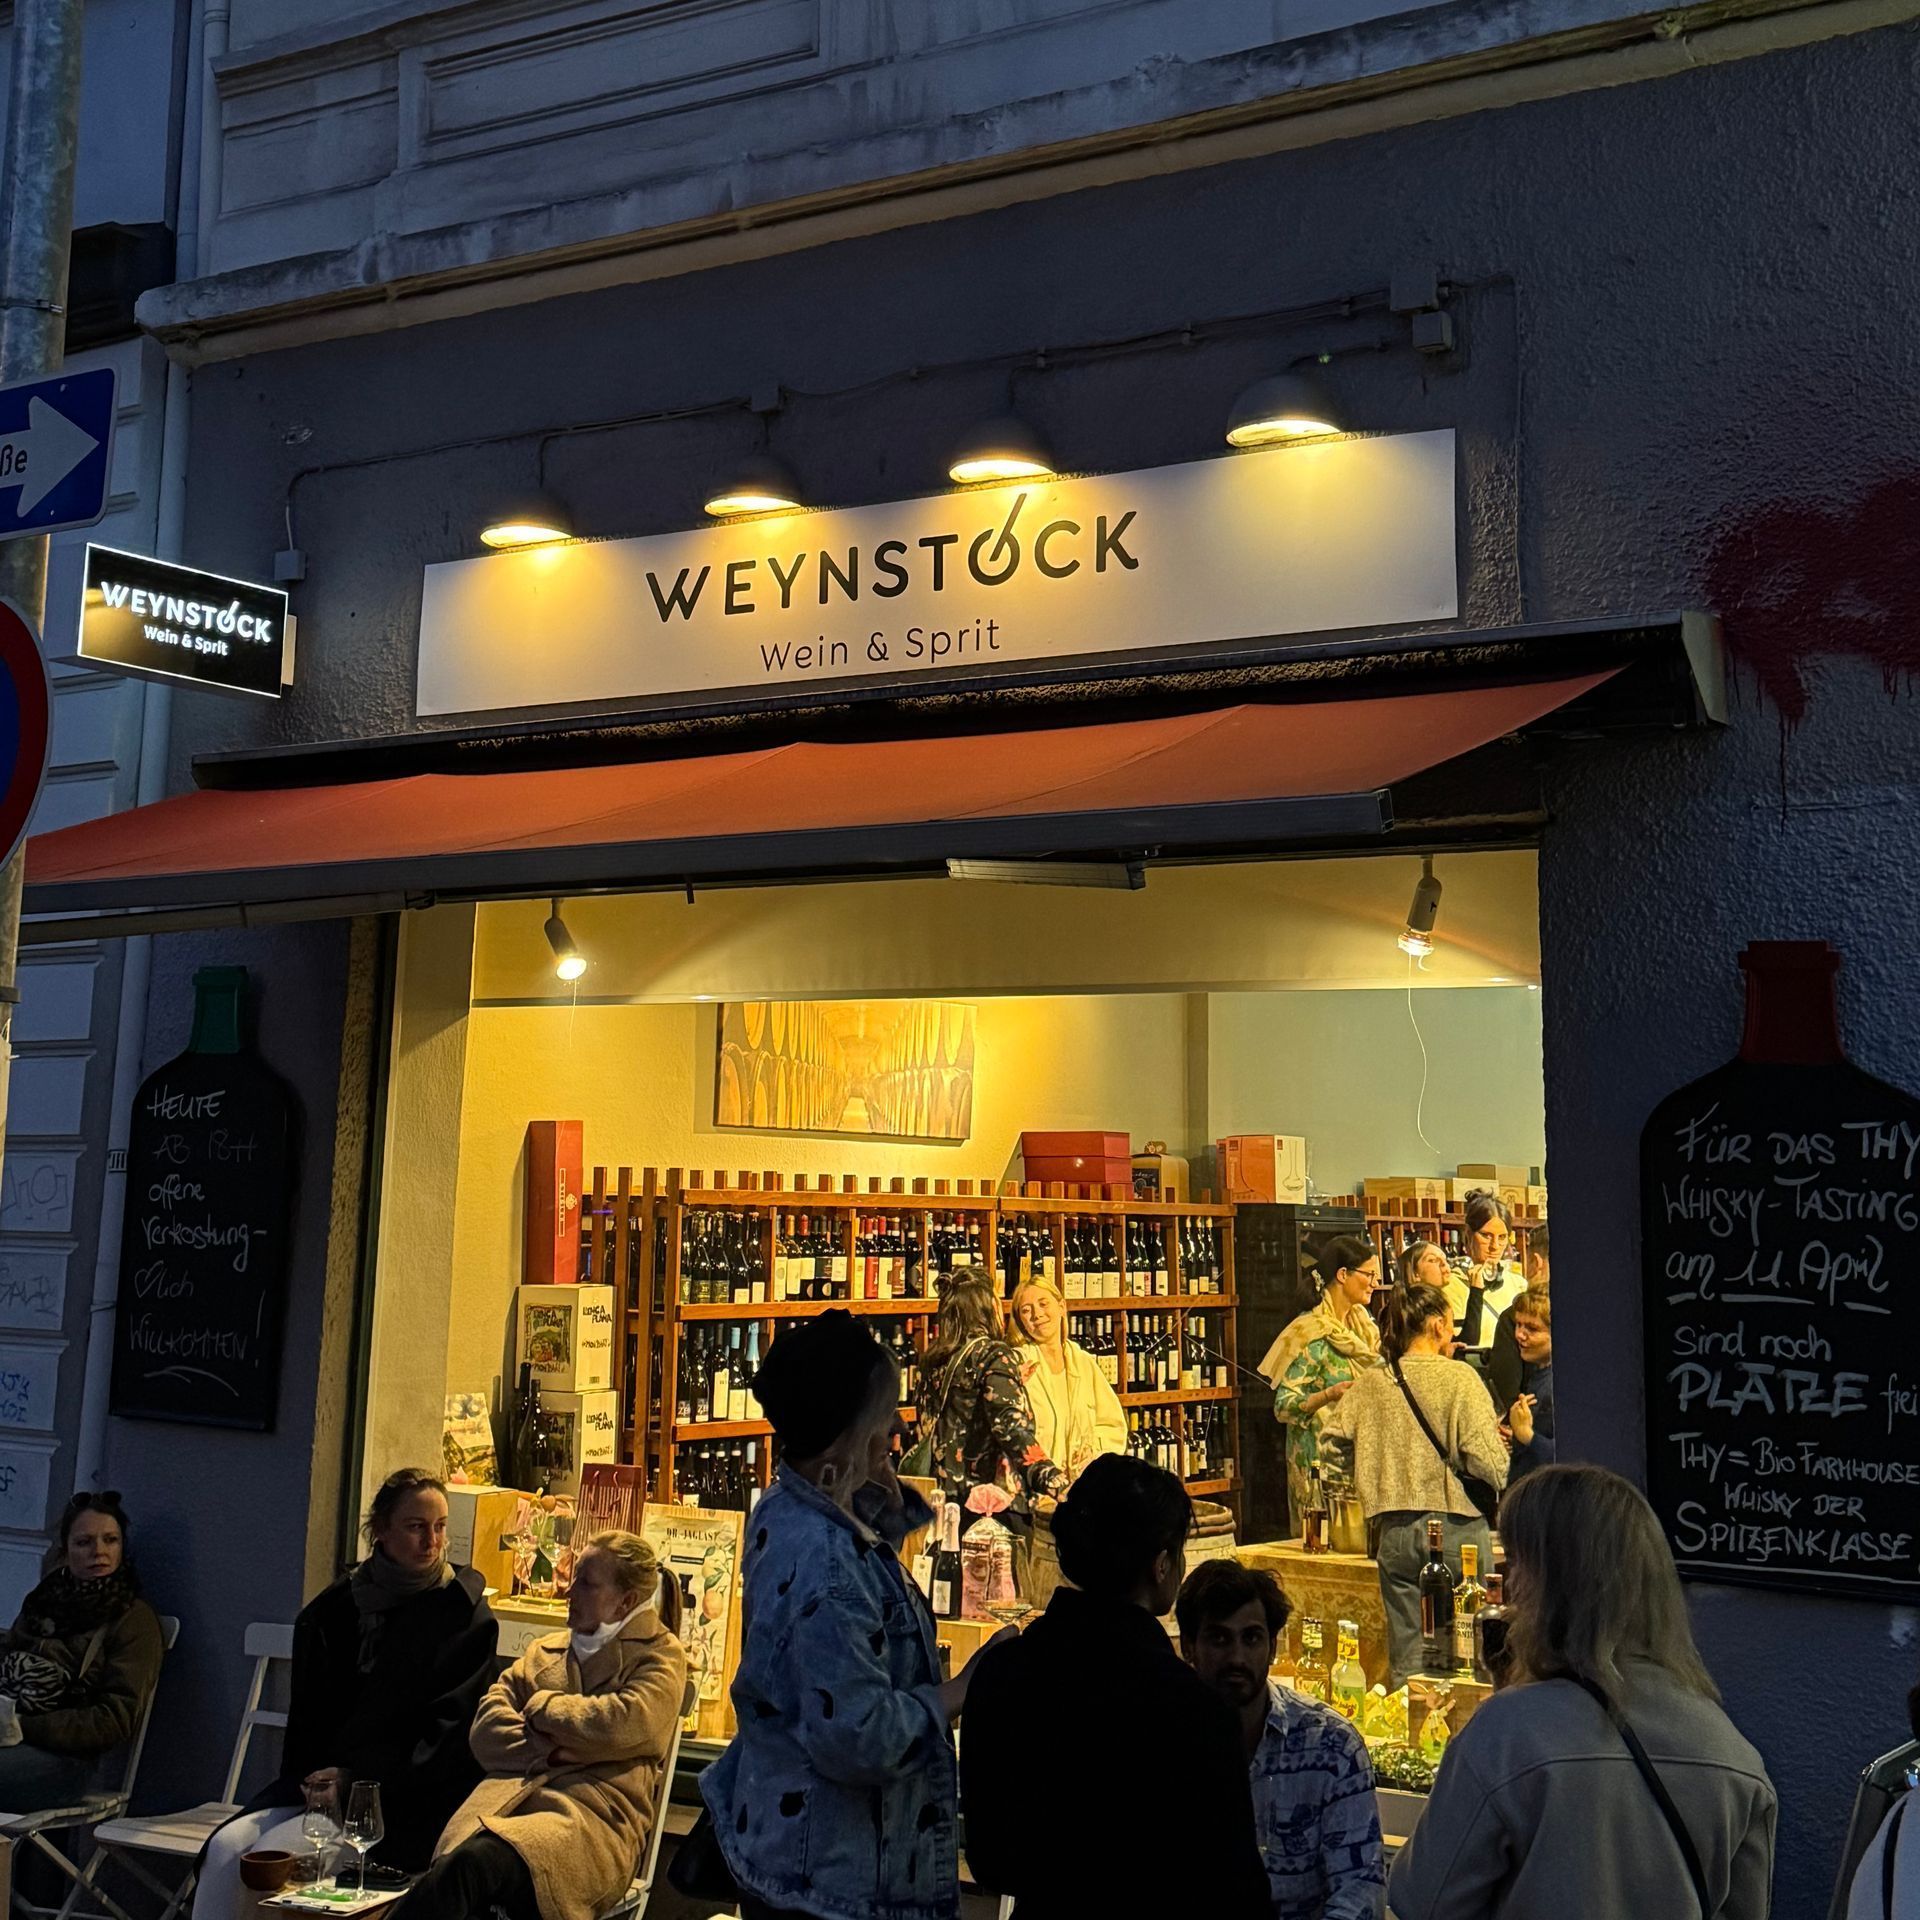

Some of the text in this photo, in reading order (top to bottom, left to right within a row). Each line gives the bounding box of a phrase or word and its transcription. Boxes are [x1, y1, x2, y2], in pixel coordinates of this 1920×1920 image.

[646, 493, 1139, 623] WEYNSTOCK
[101, 581, 272, 643] WEYNSTOCK
[143, 624, 229, 657] Wein & Sprit
[761, 618, 1000, 673] Wein & Sprit
[147, 1083, 227, 1120] HEUTE
[1766, 1132, 1836, 1166] DAS
[1840, 1120, 1920, 1181] THY
[148, 1173, 206, 1210] offene
[1665, 1250, 1716, 1301] am
[1798, 1234, 1891, 1307] April
[1759, 1323, 1833, 1362] noch
[1812, 1494, 1868, 1523] DER
